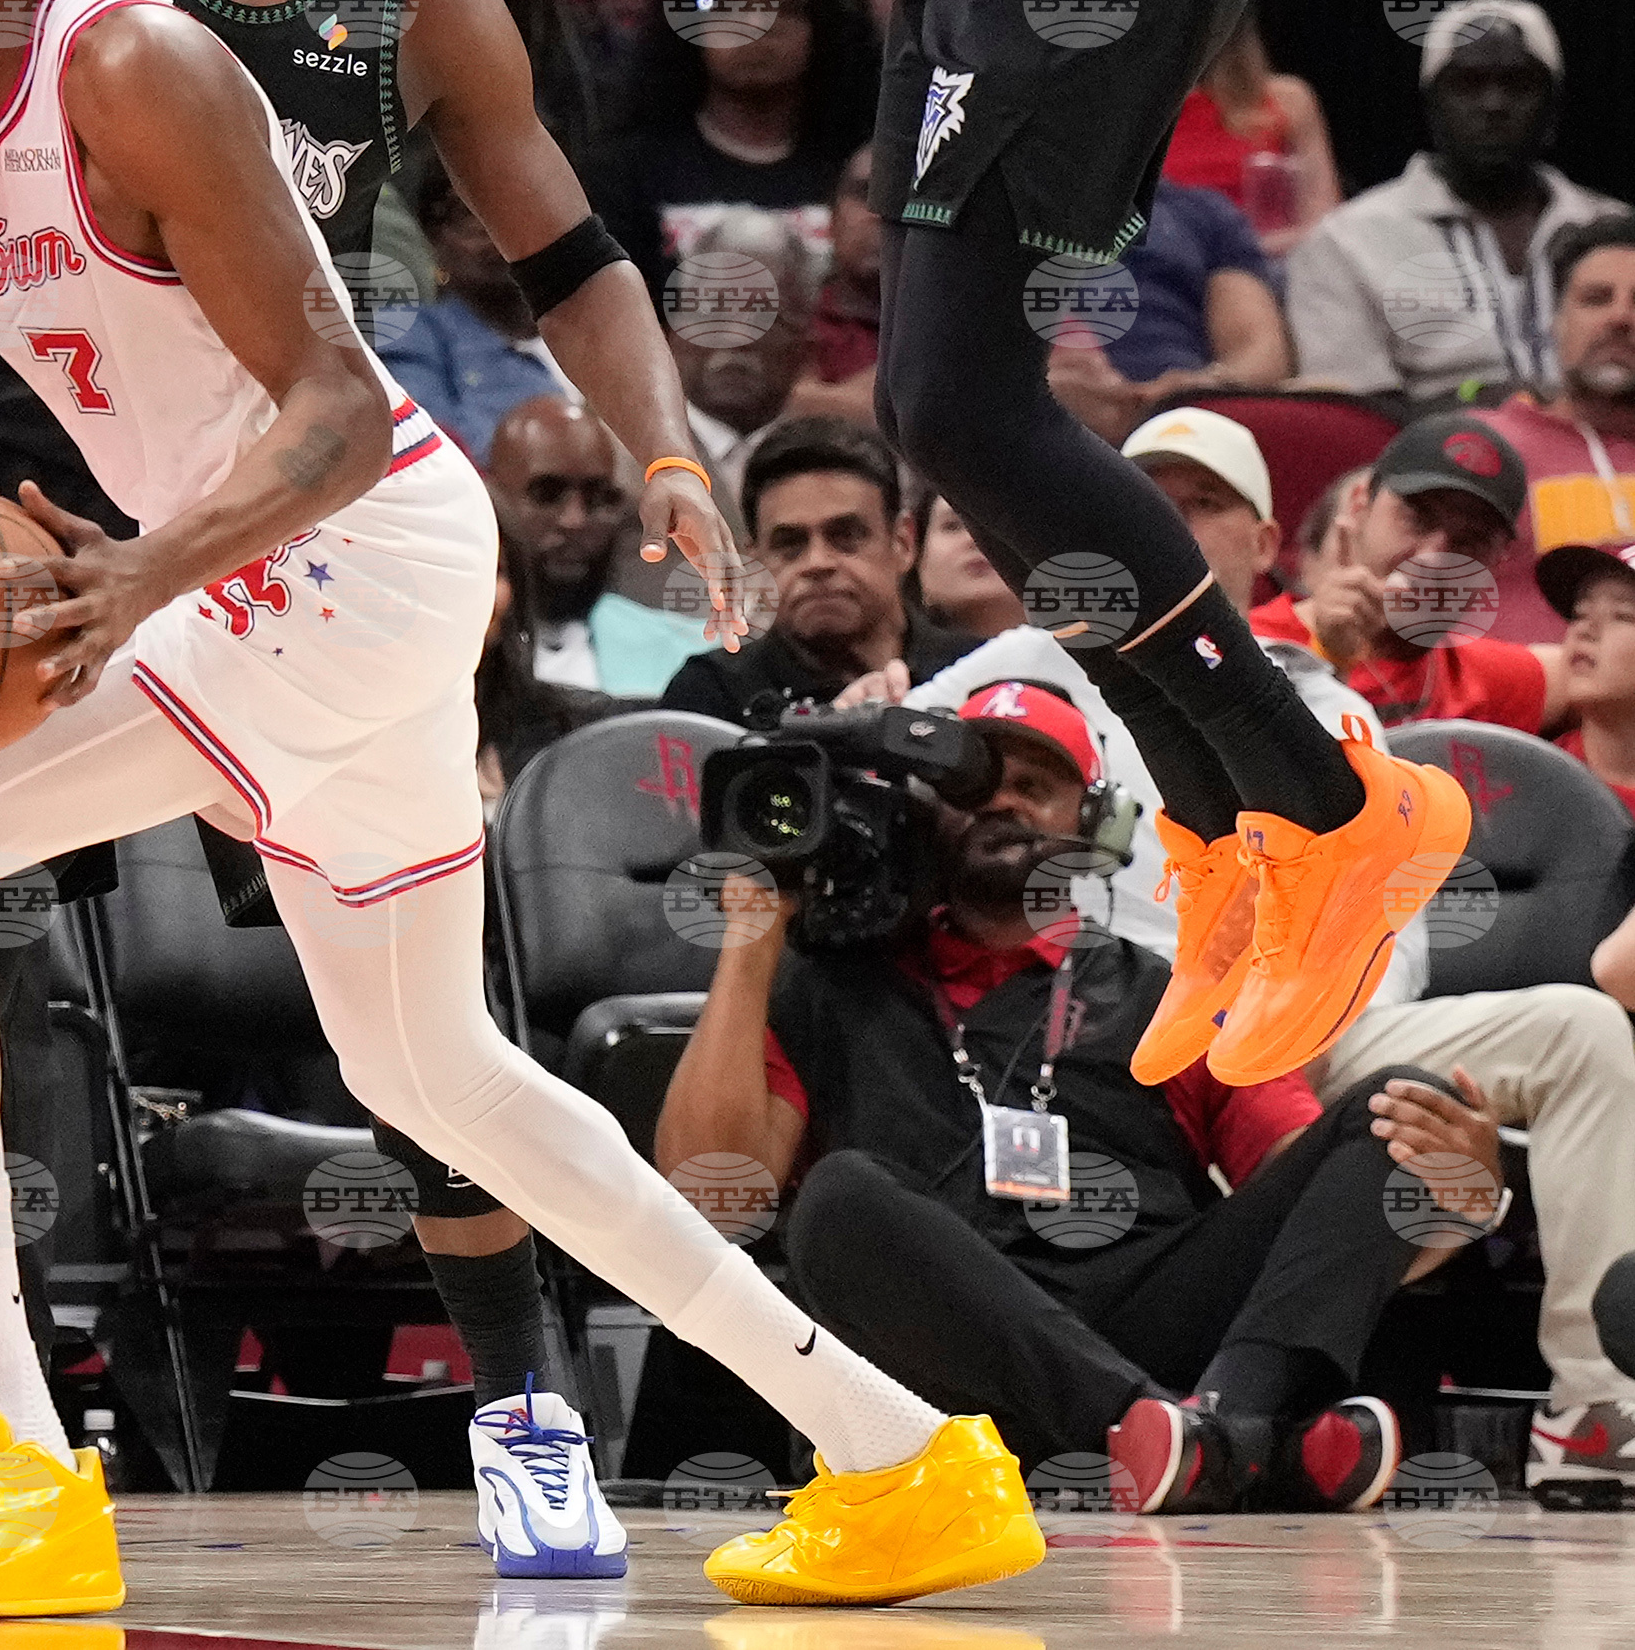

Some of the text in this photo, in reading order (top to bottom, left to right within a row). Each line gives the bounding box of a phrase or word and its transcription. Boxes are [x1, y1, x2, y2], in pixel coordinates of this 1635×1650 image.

[292, 48, 368, 77] sezzle
[4, 158, 62, 172] HERMANN
[5, 148, 60, 161] MEMORIAL
[18, 326, 116, 416] 7
